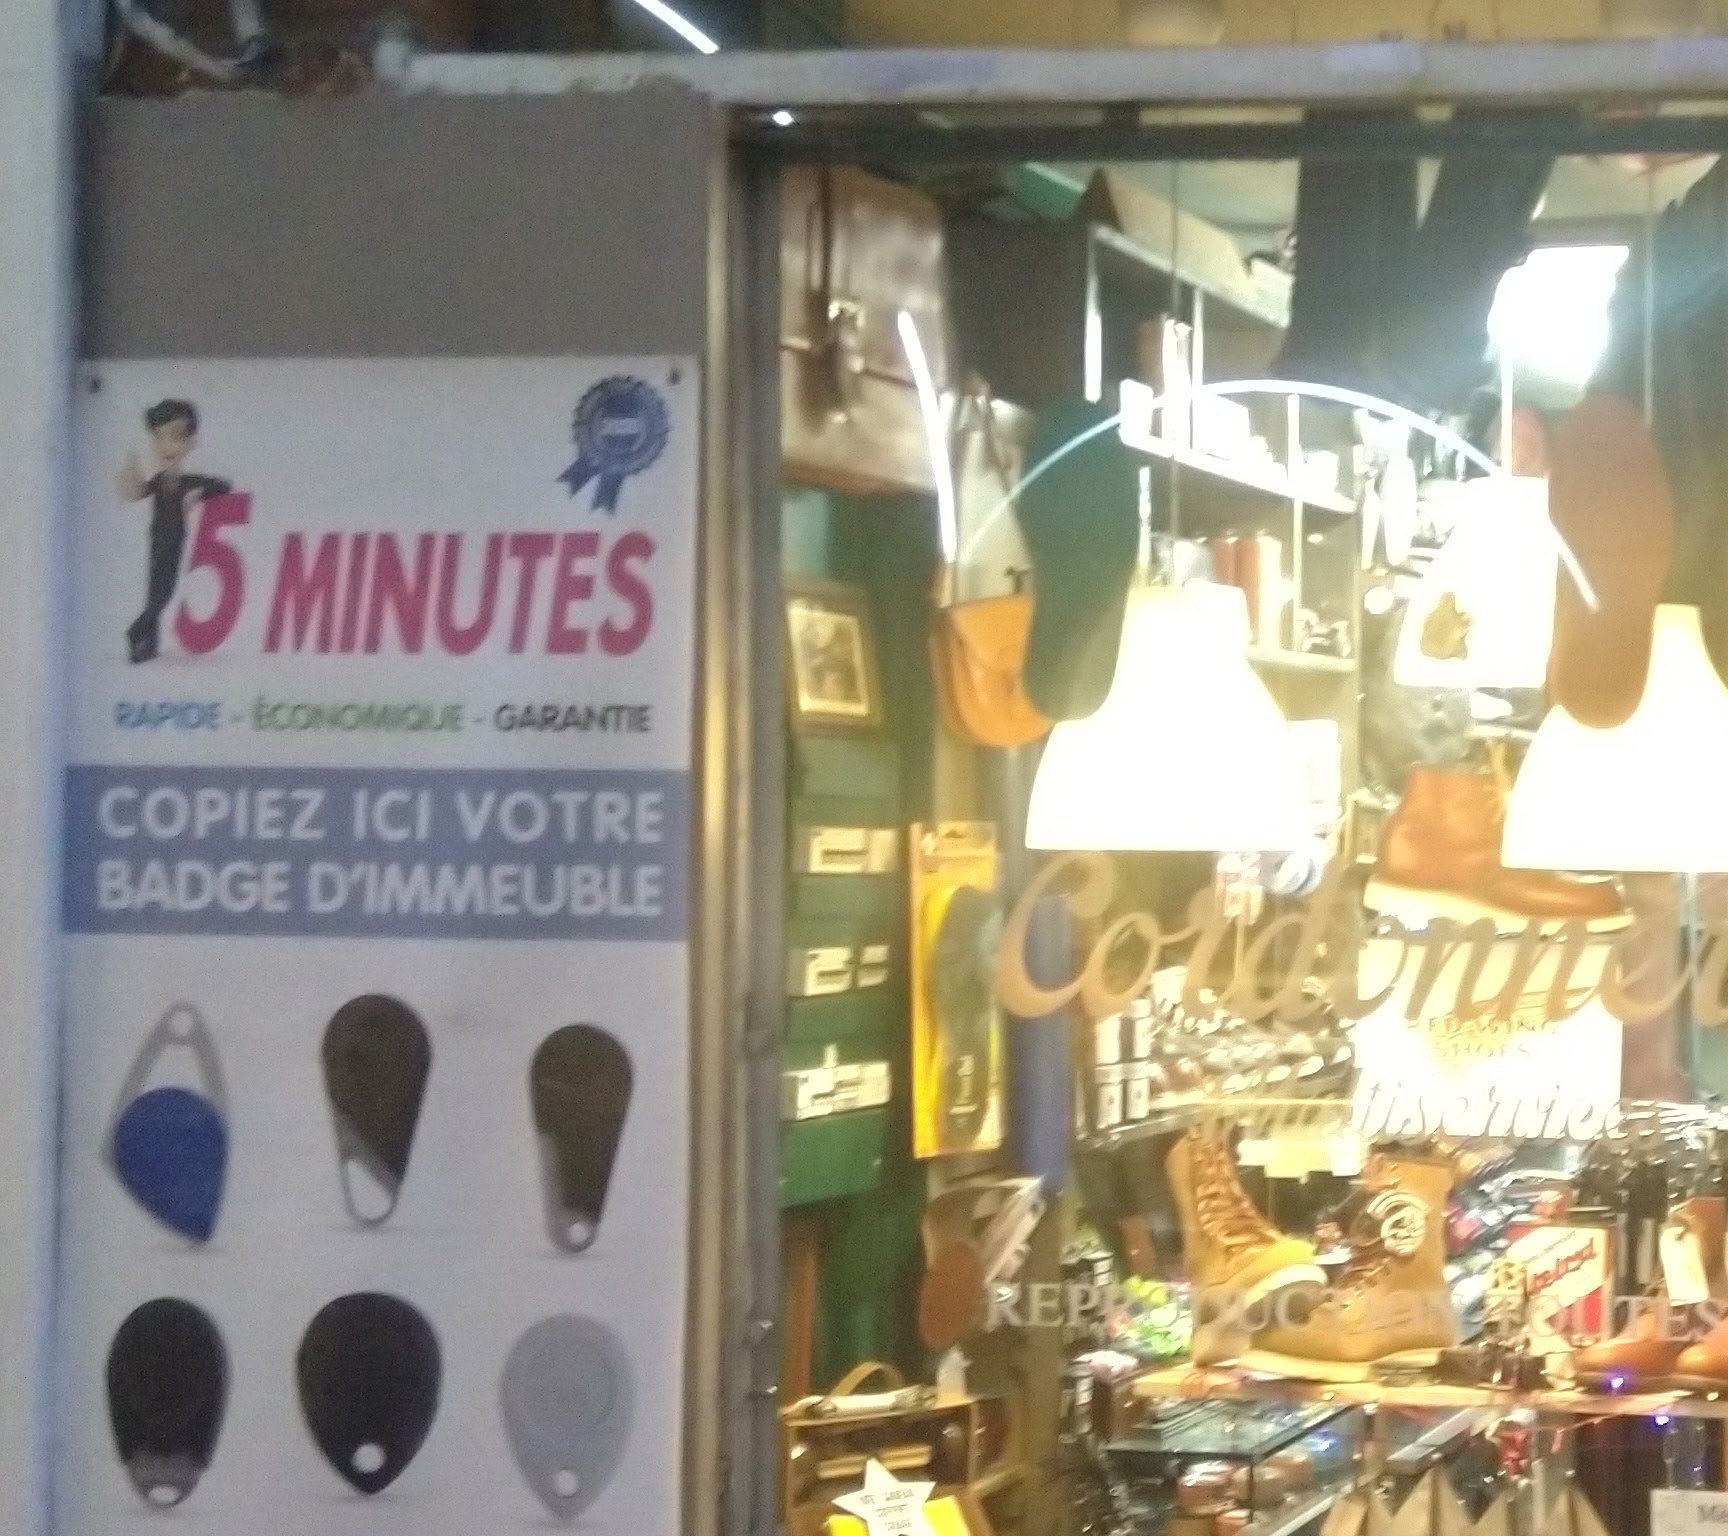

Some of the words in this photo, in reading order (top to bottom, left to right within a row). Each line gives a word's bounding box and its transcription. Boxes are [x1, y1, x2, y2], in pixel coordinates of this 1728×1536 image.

[170, 492, 253, 656] 5
[261, 530, 658, 657] MINUTES
[114, 701, 222, 731] RAPIDE
[493, 703, 653, 733] GARANTIE
[98, 785, 326, 843] COPIEZ
[352, 787, 430, 844] ICI
[455, 788, 664, 846] VOTRE
[98, 858, 290, 914] BADGE
[305, 860, 663, 919] D'IMMEUBLE
